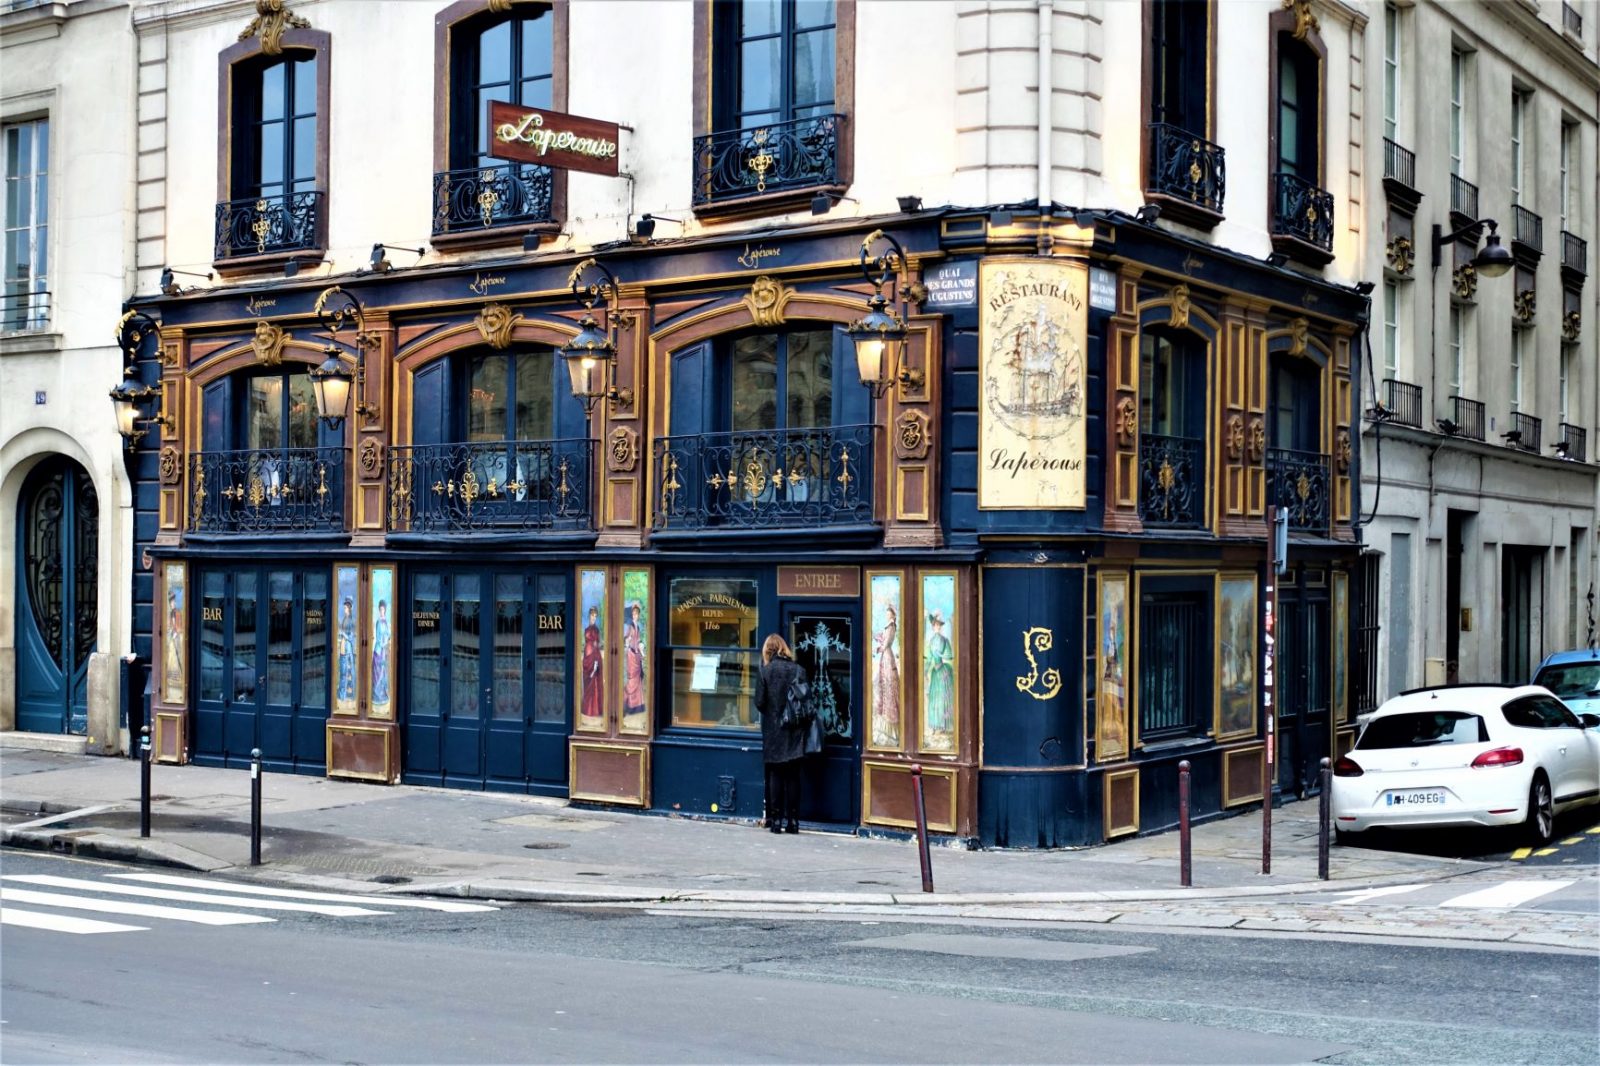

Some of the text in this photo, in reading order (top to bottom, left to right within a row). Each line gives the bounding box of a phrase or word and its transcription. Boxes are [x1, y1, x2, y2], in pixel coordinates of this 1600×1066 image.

[939, 268, 960, 279] QUAI
[941, 278, 975, 289] GRANDS
[989, 283, 1083, 313] RESTAURANT
[677, 593, 751, 615] MAISON PARISIENNE
[203, 607, 222, 621] BAR
[702, 609, 724, 617] DEPUIS
[539, 615, 563, 630] BAR
[705, 621, 720, 630] 1766
